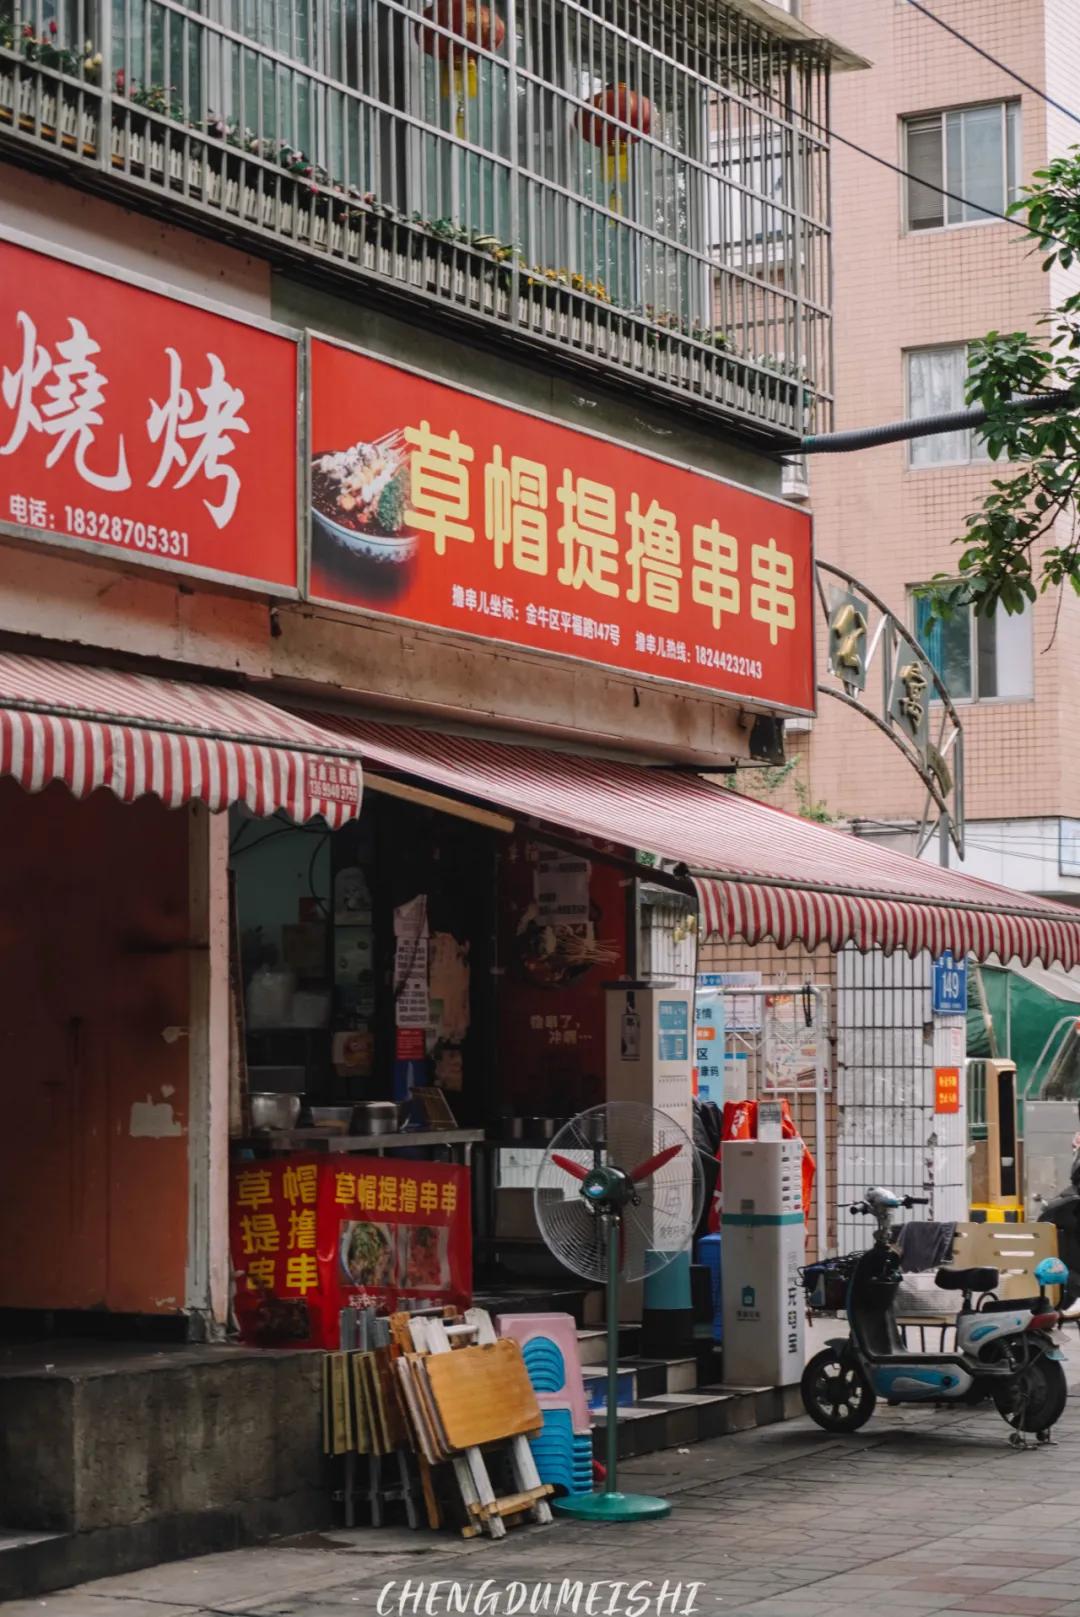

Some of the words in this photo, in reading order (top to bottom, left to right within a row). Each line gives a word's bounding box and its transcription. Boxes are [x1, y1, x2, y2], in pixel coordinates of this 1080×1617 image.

[0, 310, 250, 529] 燒烤
[404, 420, 796, 645] 草帽提撸串串
[942, 972, 960, 999] 149
[235, 1164, 317, 1210] 草帽
[334, 1173, 458, 1217] 草帽提撸串串
[240, 1209, 317, 1254] 提撸
